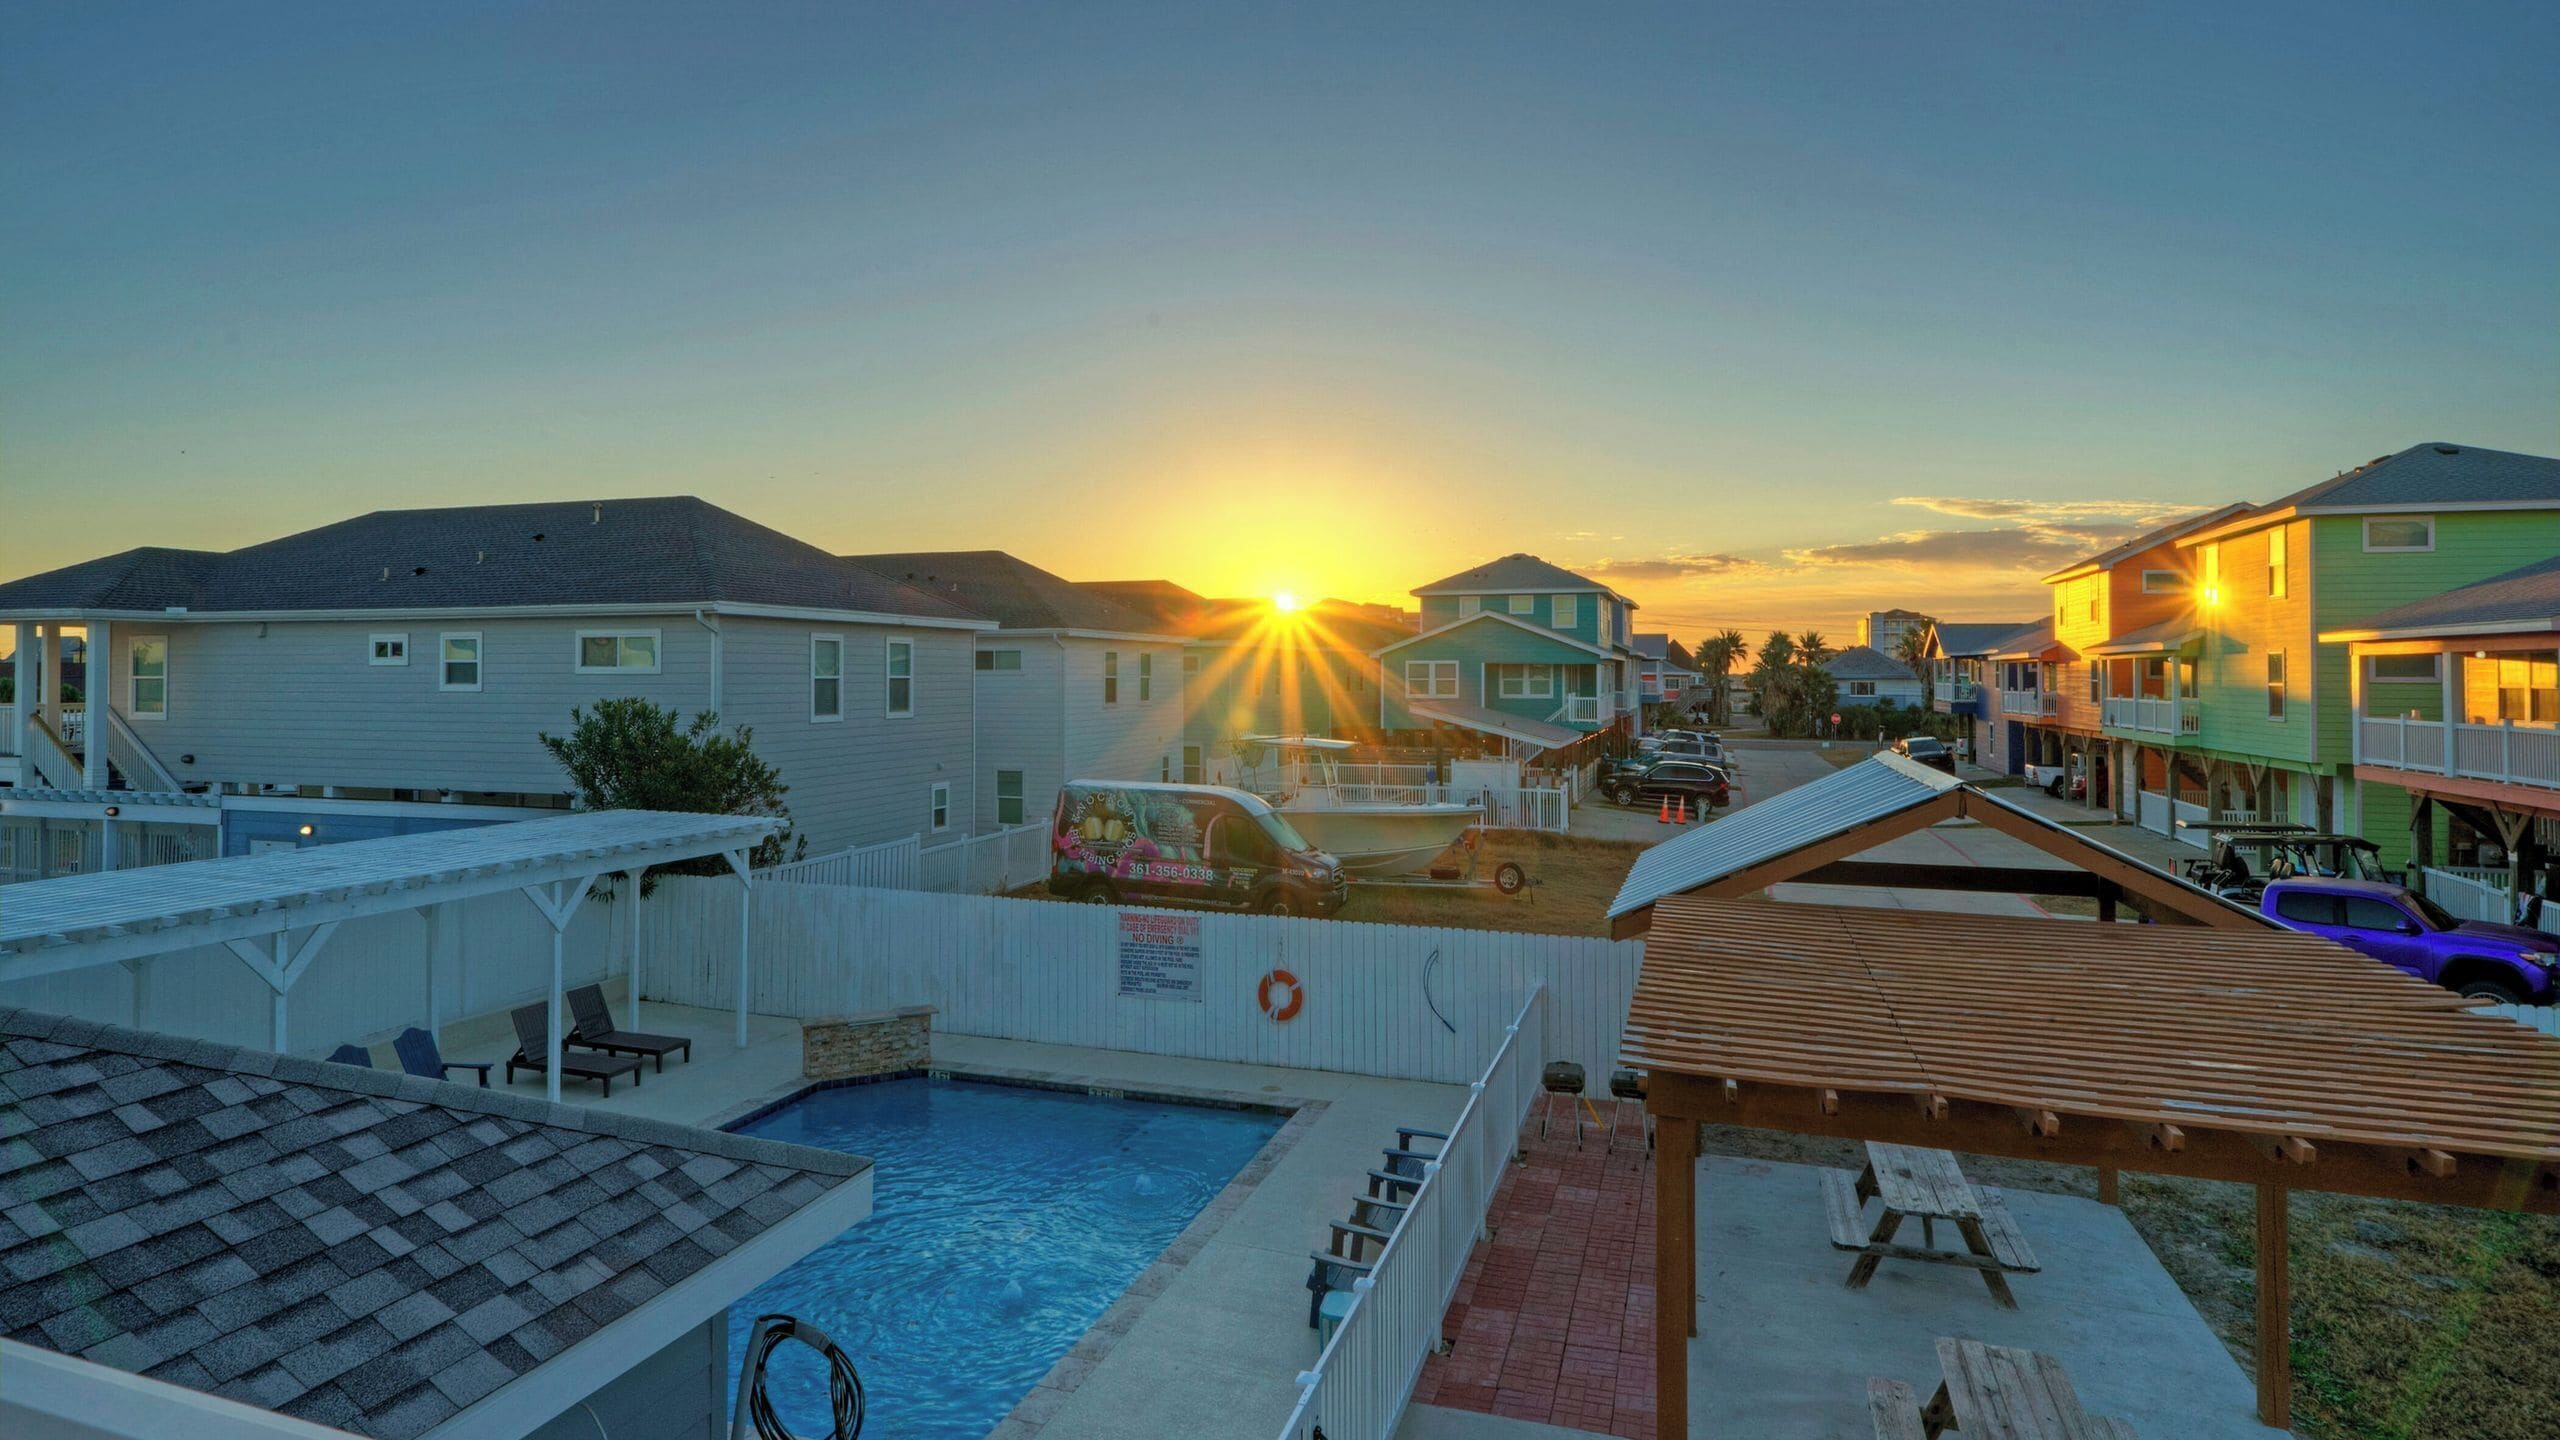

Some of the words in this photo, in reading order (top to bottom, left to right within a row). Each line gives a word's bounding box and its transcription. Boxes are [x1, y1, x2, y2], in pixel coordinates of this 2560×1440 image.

[1129, 863, 1214, 881] 361-356-0338
[1147, 923, 1177, 935] EMERGENCY
[1132, 933, 1145, 943] NO
[1146, 934, 1175, 945] DIVING
[940, 1072, 949, 1080] FT
